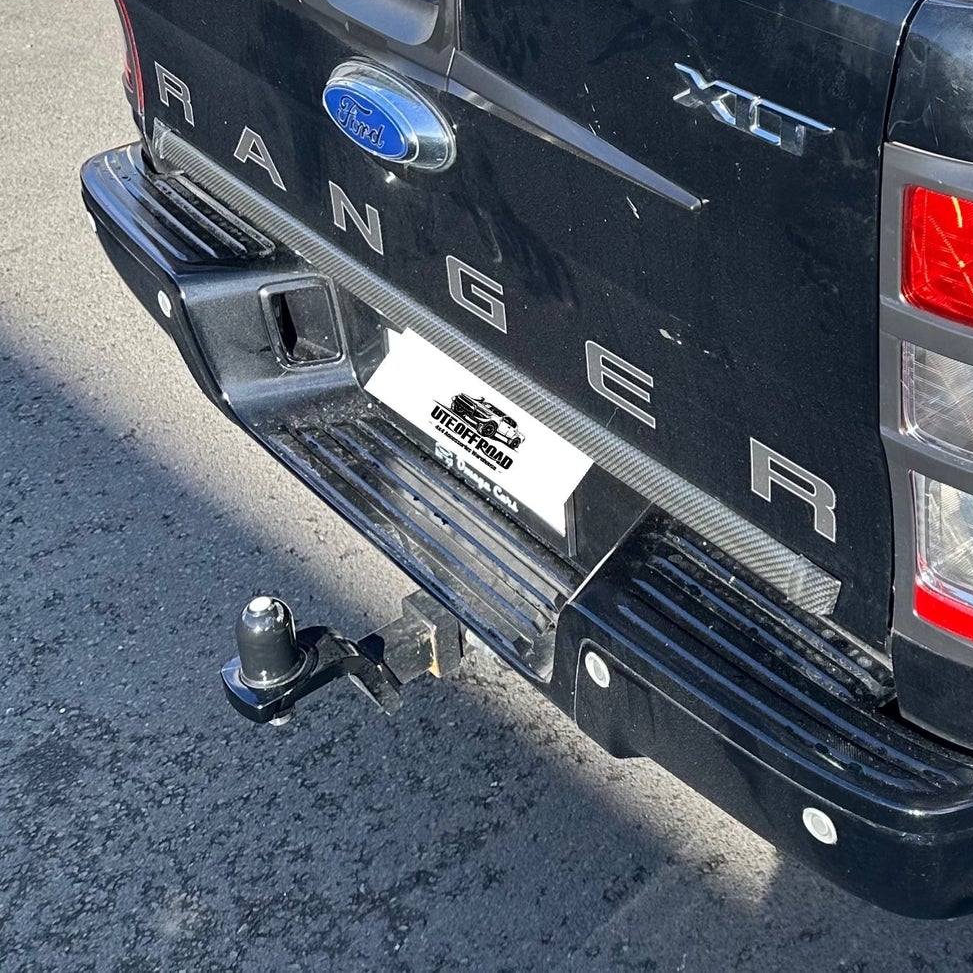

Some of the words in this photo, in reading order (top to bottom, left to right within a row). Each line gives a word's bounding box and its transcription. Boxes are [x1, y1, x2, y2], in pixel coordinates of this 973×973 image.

[336, 94, 386, 149] Ford
[673, 62, 836, 157] XLT
[155, 62, 837, 543] RANGER
[456, 458, 492, 491] Omega
[493, 485, 519, 513] Cars
